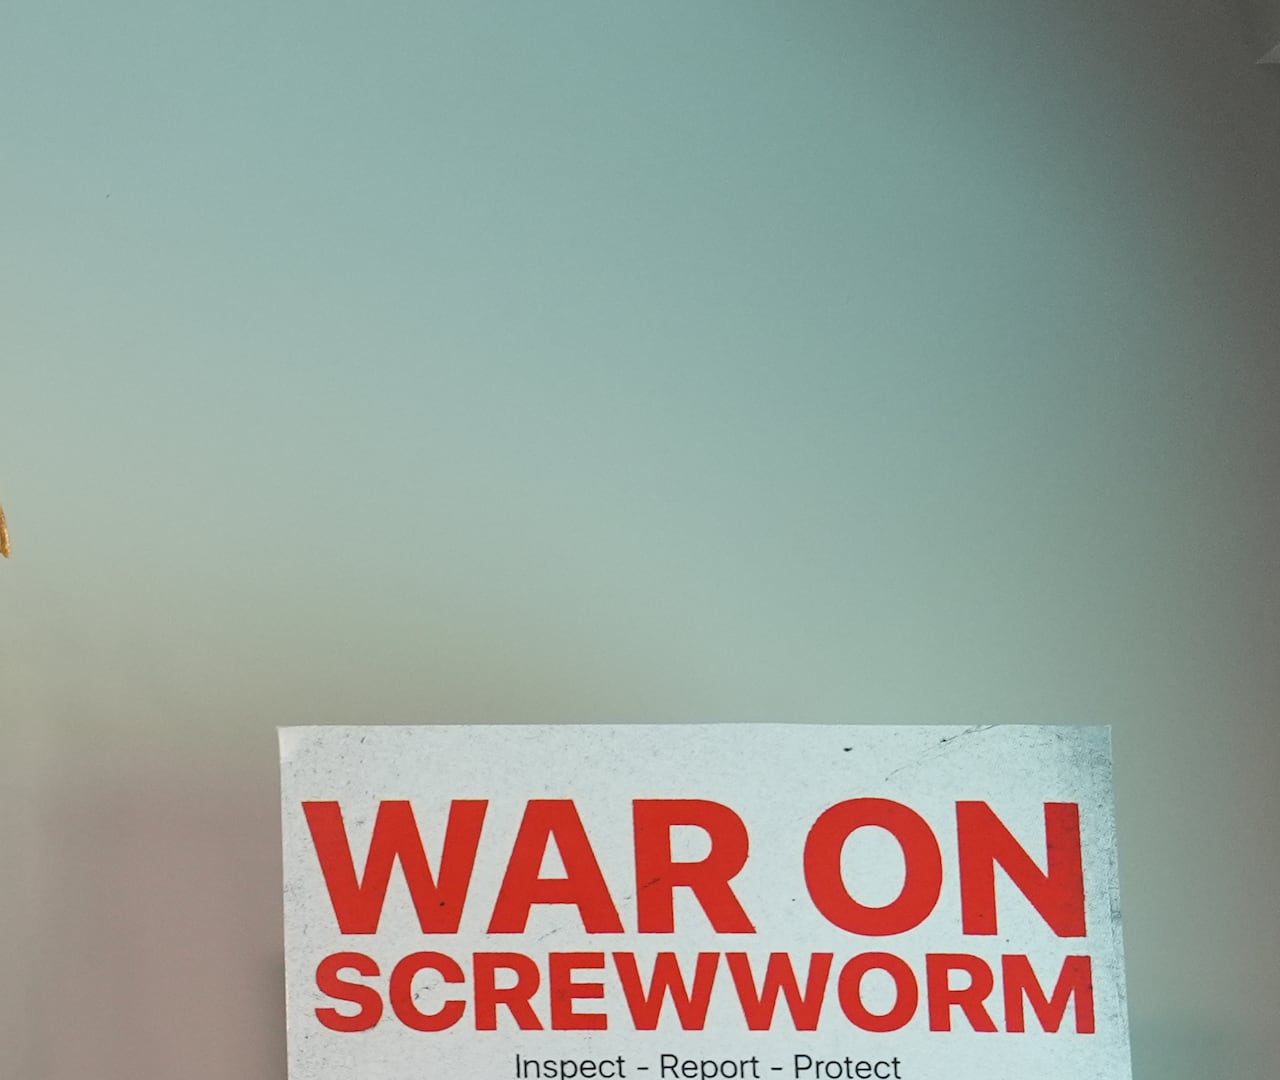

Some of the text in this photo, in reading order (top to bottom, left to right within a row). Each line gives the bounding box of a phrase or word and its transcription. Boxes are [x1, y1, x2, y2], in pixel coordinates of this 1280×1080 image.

[302, 797, 1088, 938] WAR ON
[314, 951, 1096, 1035] SCREWWORM
[794, 1054, 902, 1080] Protect
